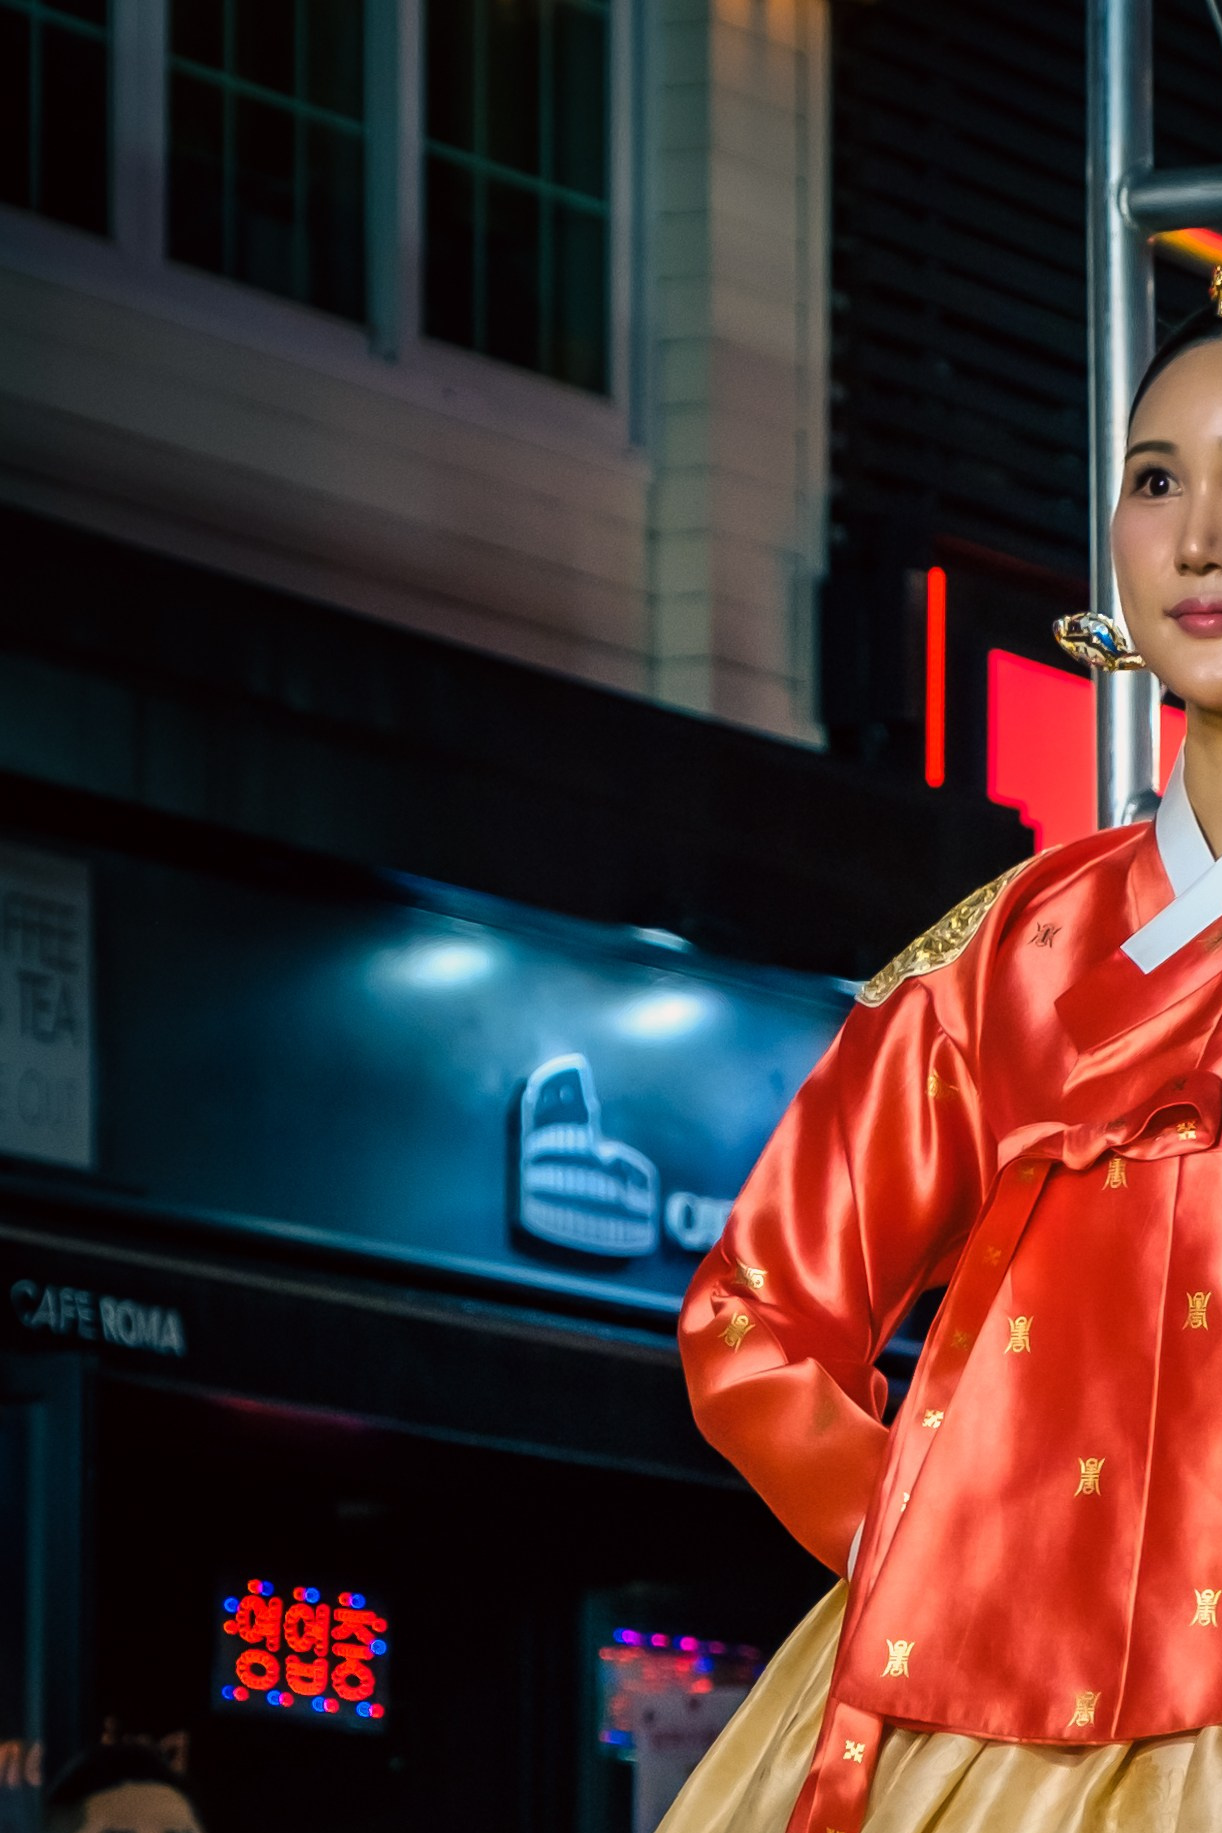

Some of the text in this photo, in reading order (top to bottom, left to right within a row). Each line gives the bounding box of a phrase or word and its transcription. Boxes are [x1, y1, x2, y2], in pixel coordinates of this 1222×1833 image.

[10, 1279, 188, 1358] CAFE ROMA
[235, 1594, 377, 1702] 영업중
